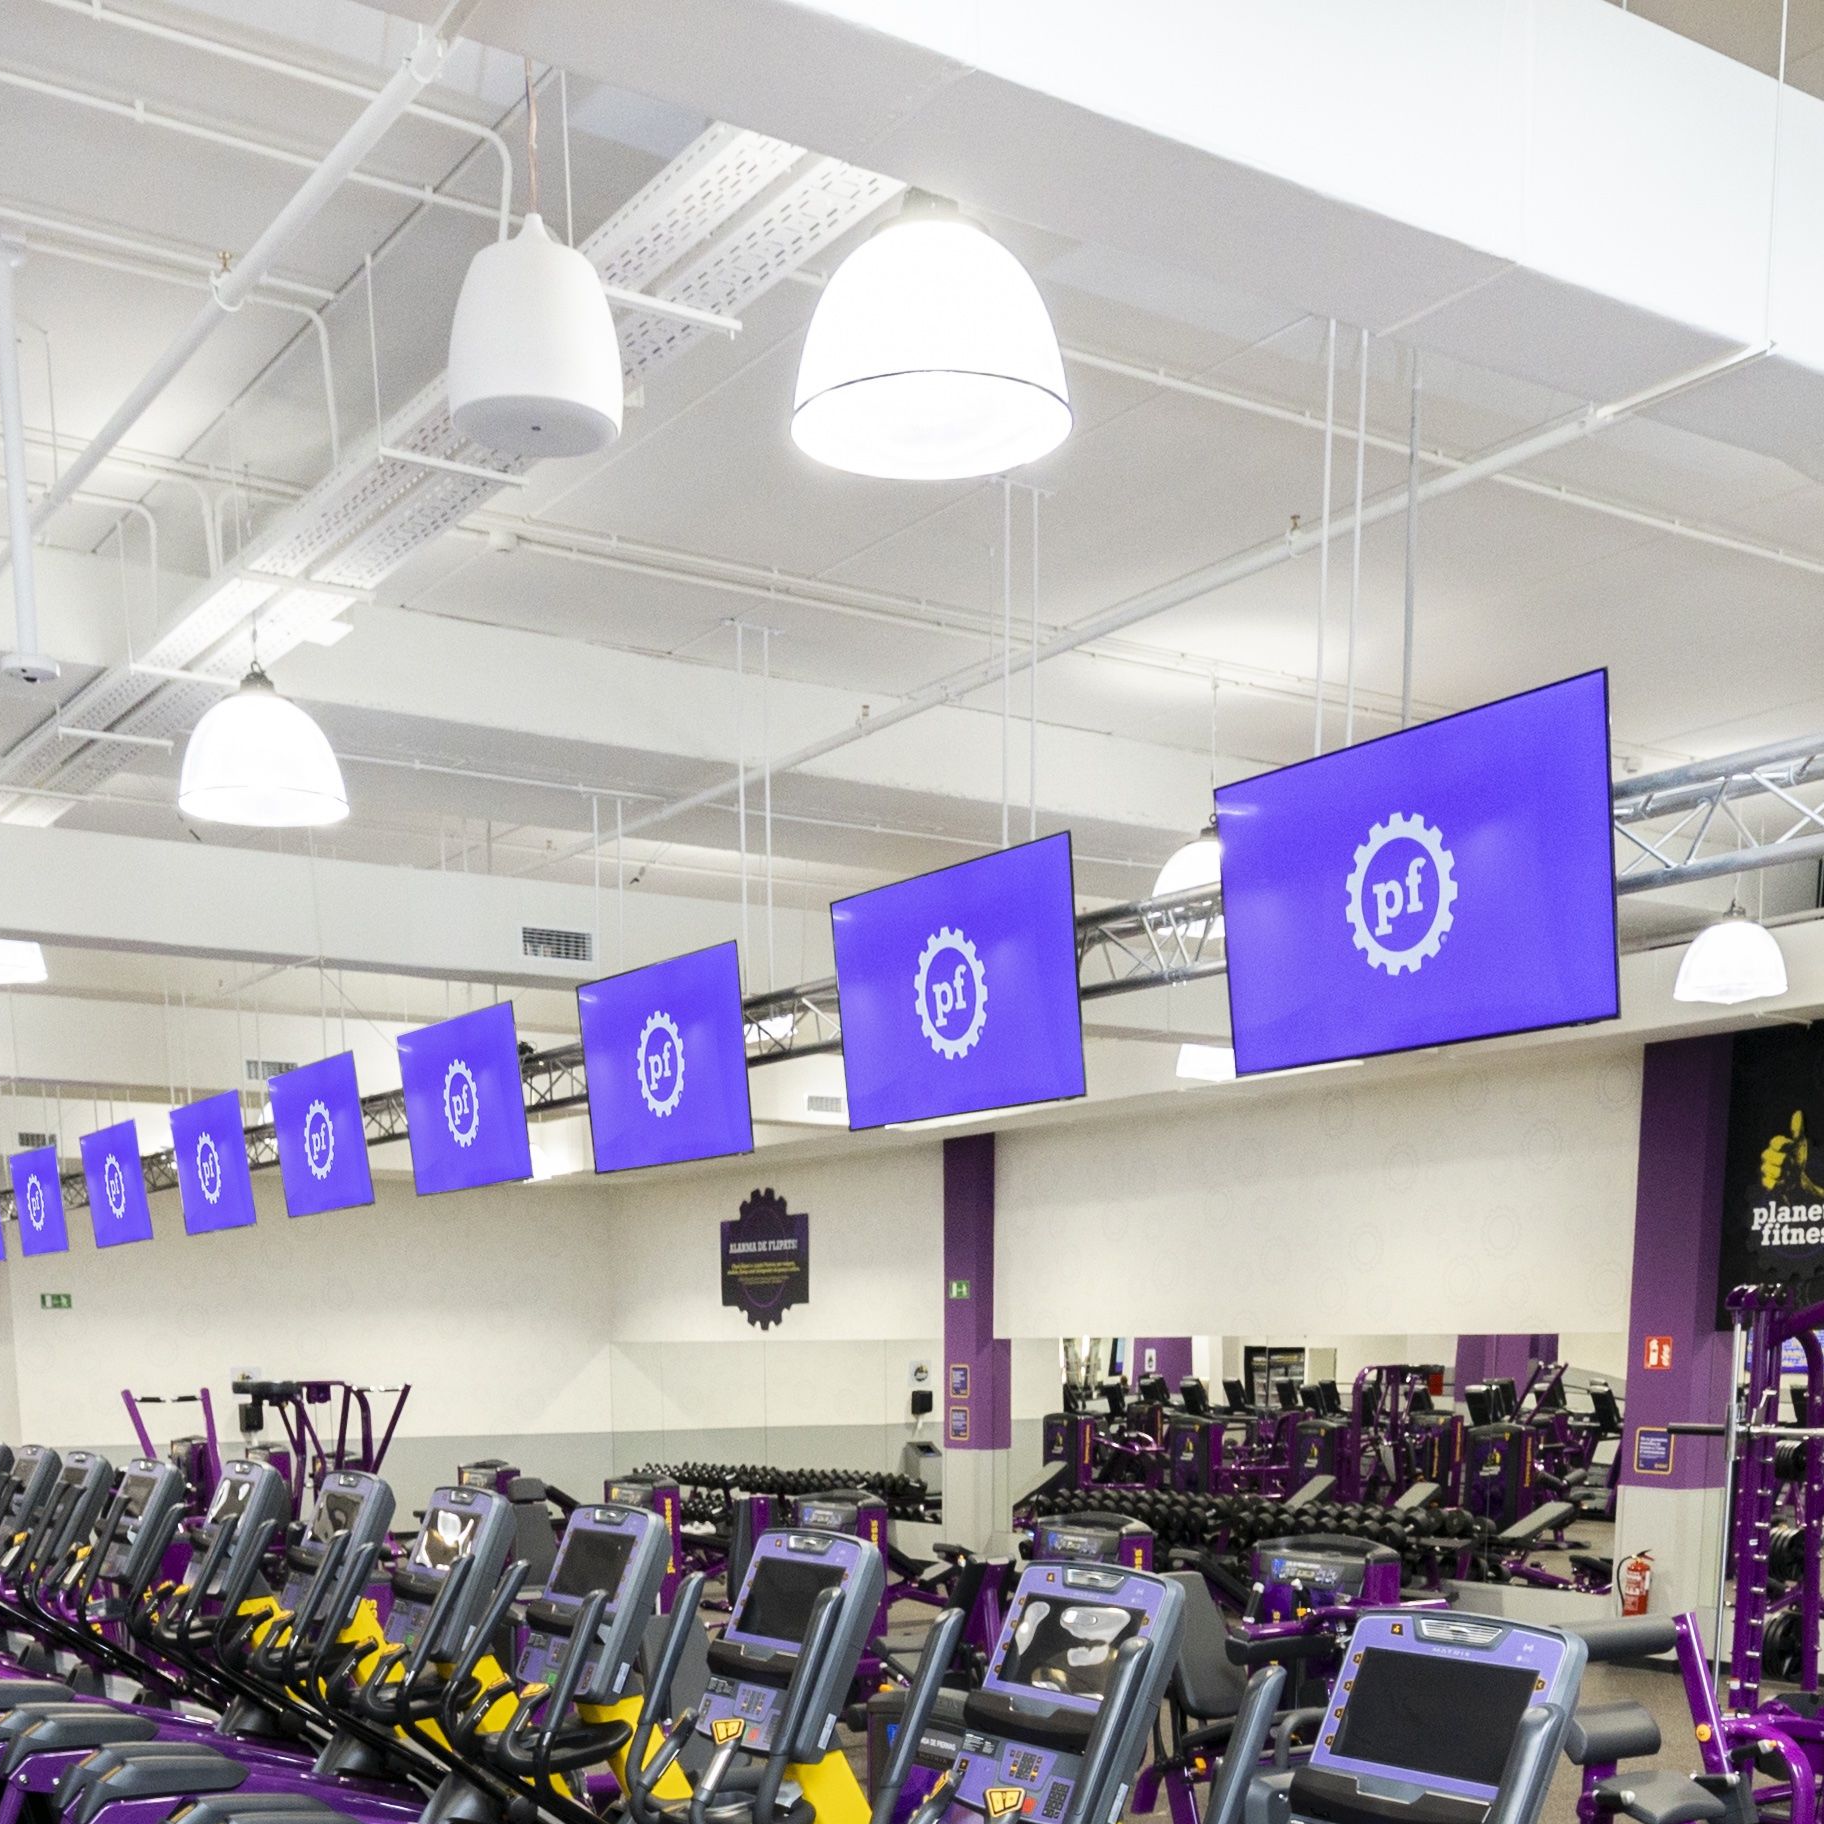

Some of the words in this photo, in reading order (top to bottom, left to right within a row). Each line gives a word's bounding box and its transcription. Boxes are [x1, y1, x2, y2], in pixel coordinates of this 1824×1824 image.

[1373, 858, 1426, 936] pf
[932, 965, 966, 1027] pf
[649, 1042, 671, 1090] pf
[452, 1084, 469, 1125] pf
[312, 1123, 326, 1160] pf
[110, 1172, 121, 1202] pf
[202, 1153, 214, 1186] pf
[32, 1191, 41, 1217] pf
